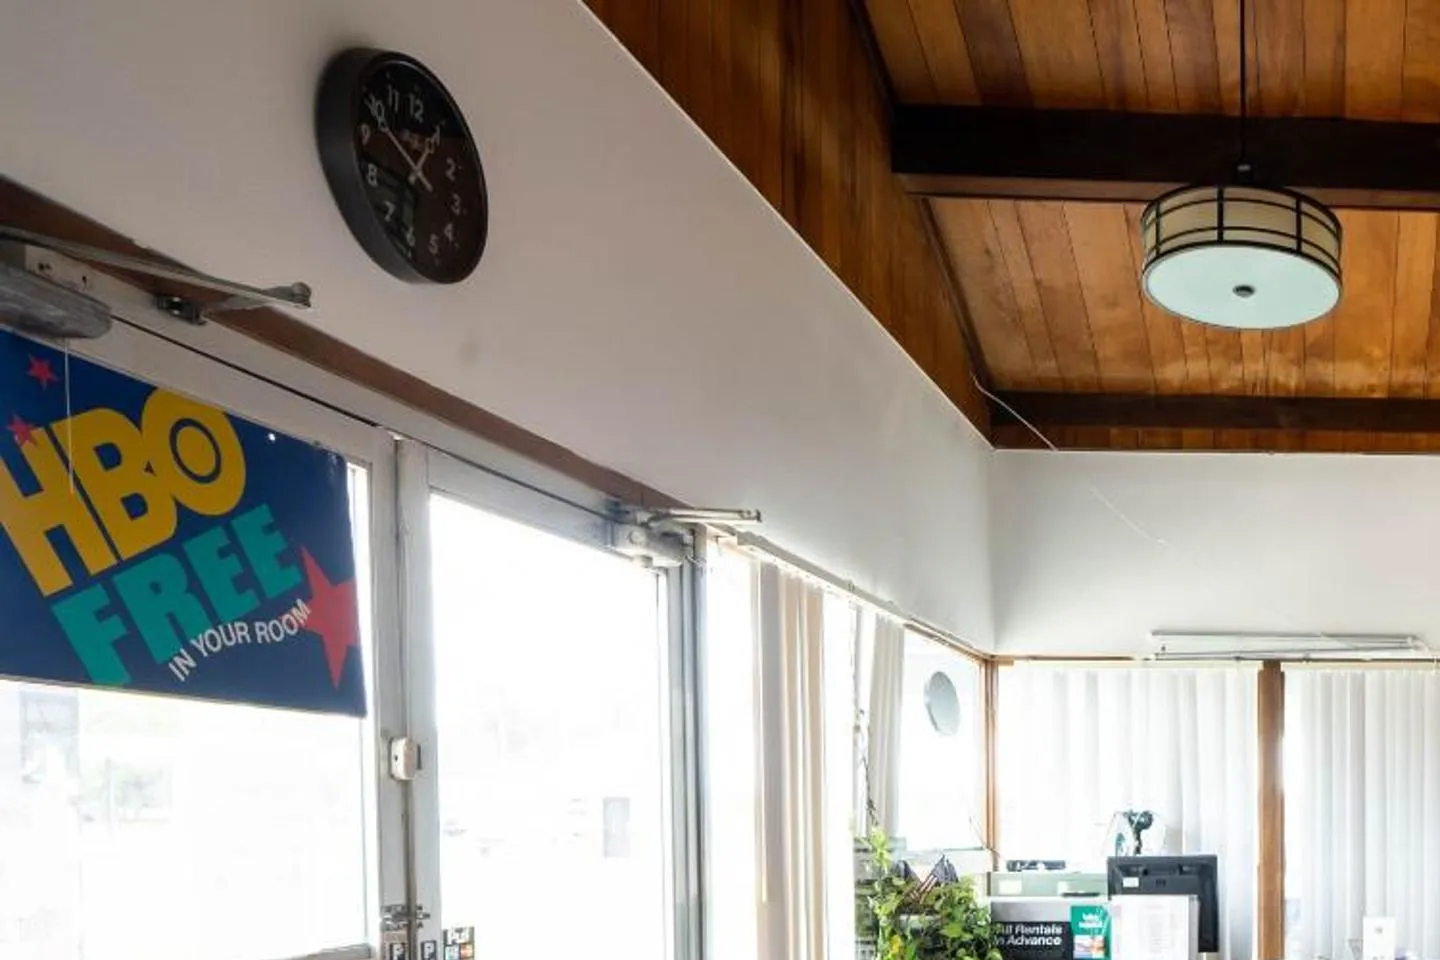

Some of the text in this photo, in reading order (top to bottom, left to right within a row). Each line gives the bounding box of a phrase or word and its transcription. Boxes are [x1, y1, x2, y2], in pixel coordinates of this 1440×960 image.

[0, 387, 246, 597] HBO
[52, 504, 303, 687] FREE
[168, 598, 312, 682] IN YOUR ROOM
[1007, 933, 1063, 946] Advance
[1015, 923, 1063, 935] Rentals
